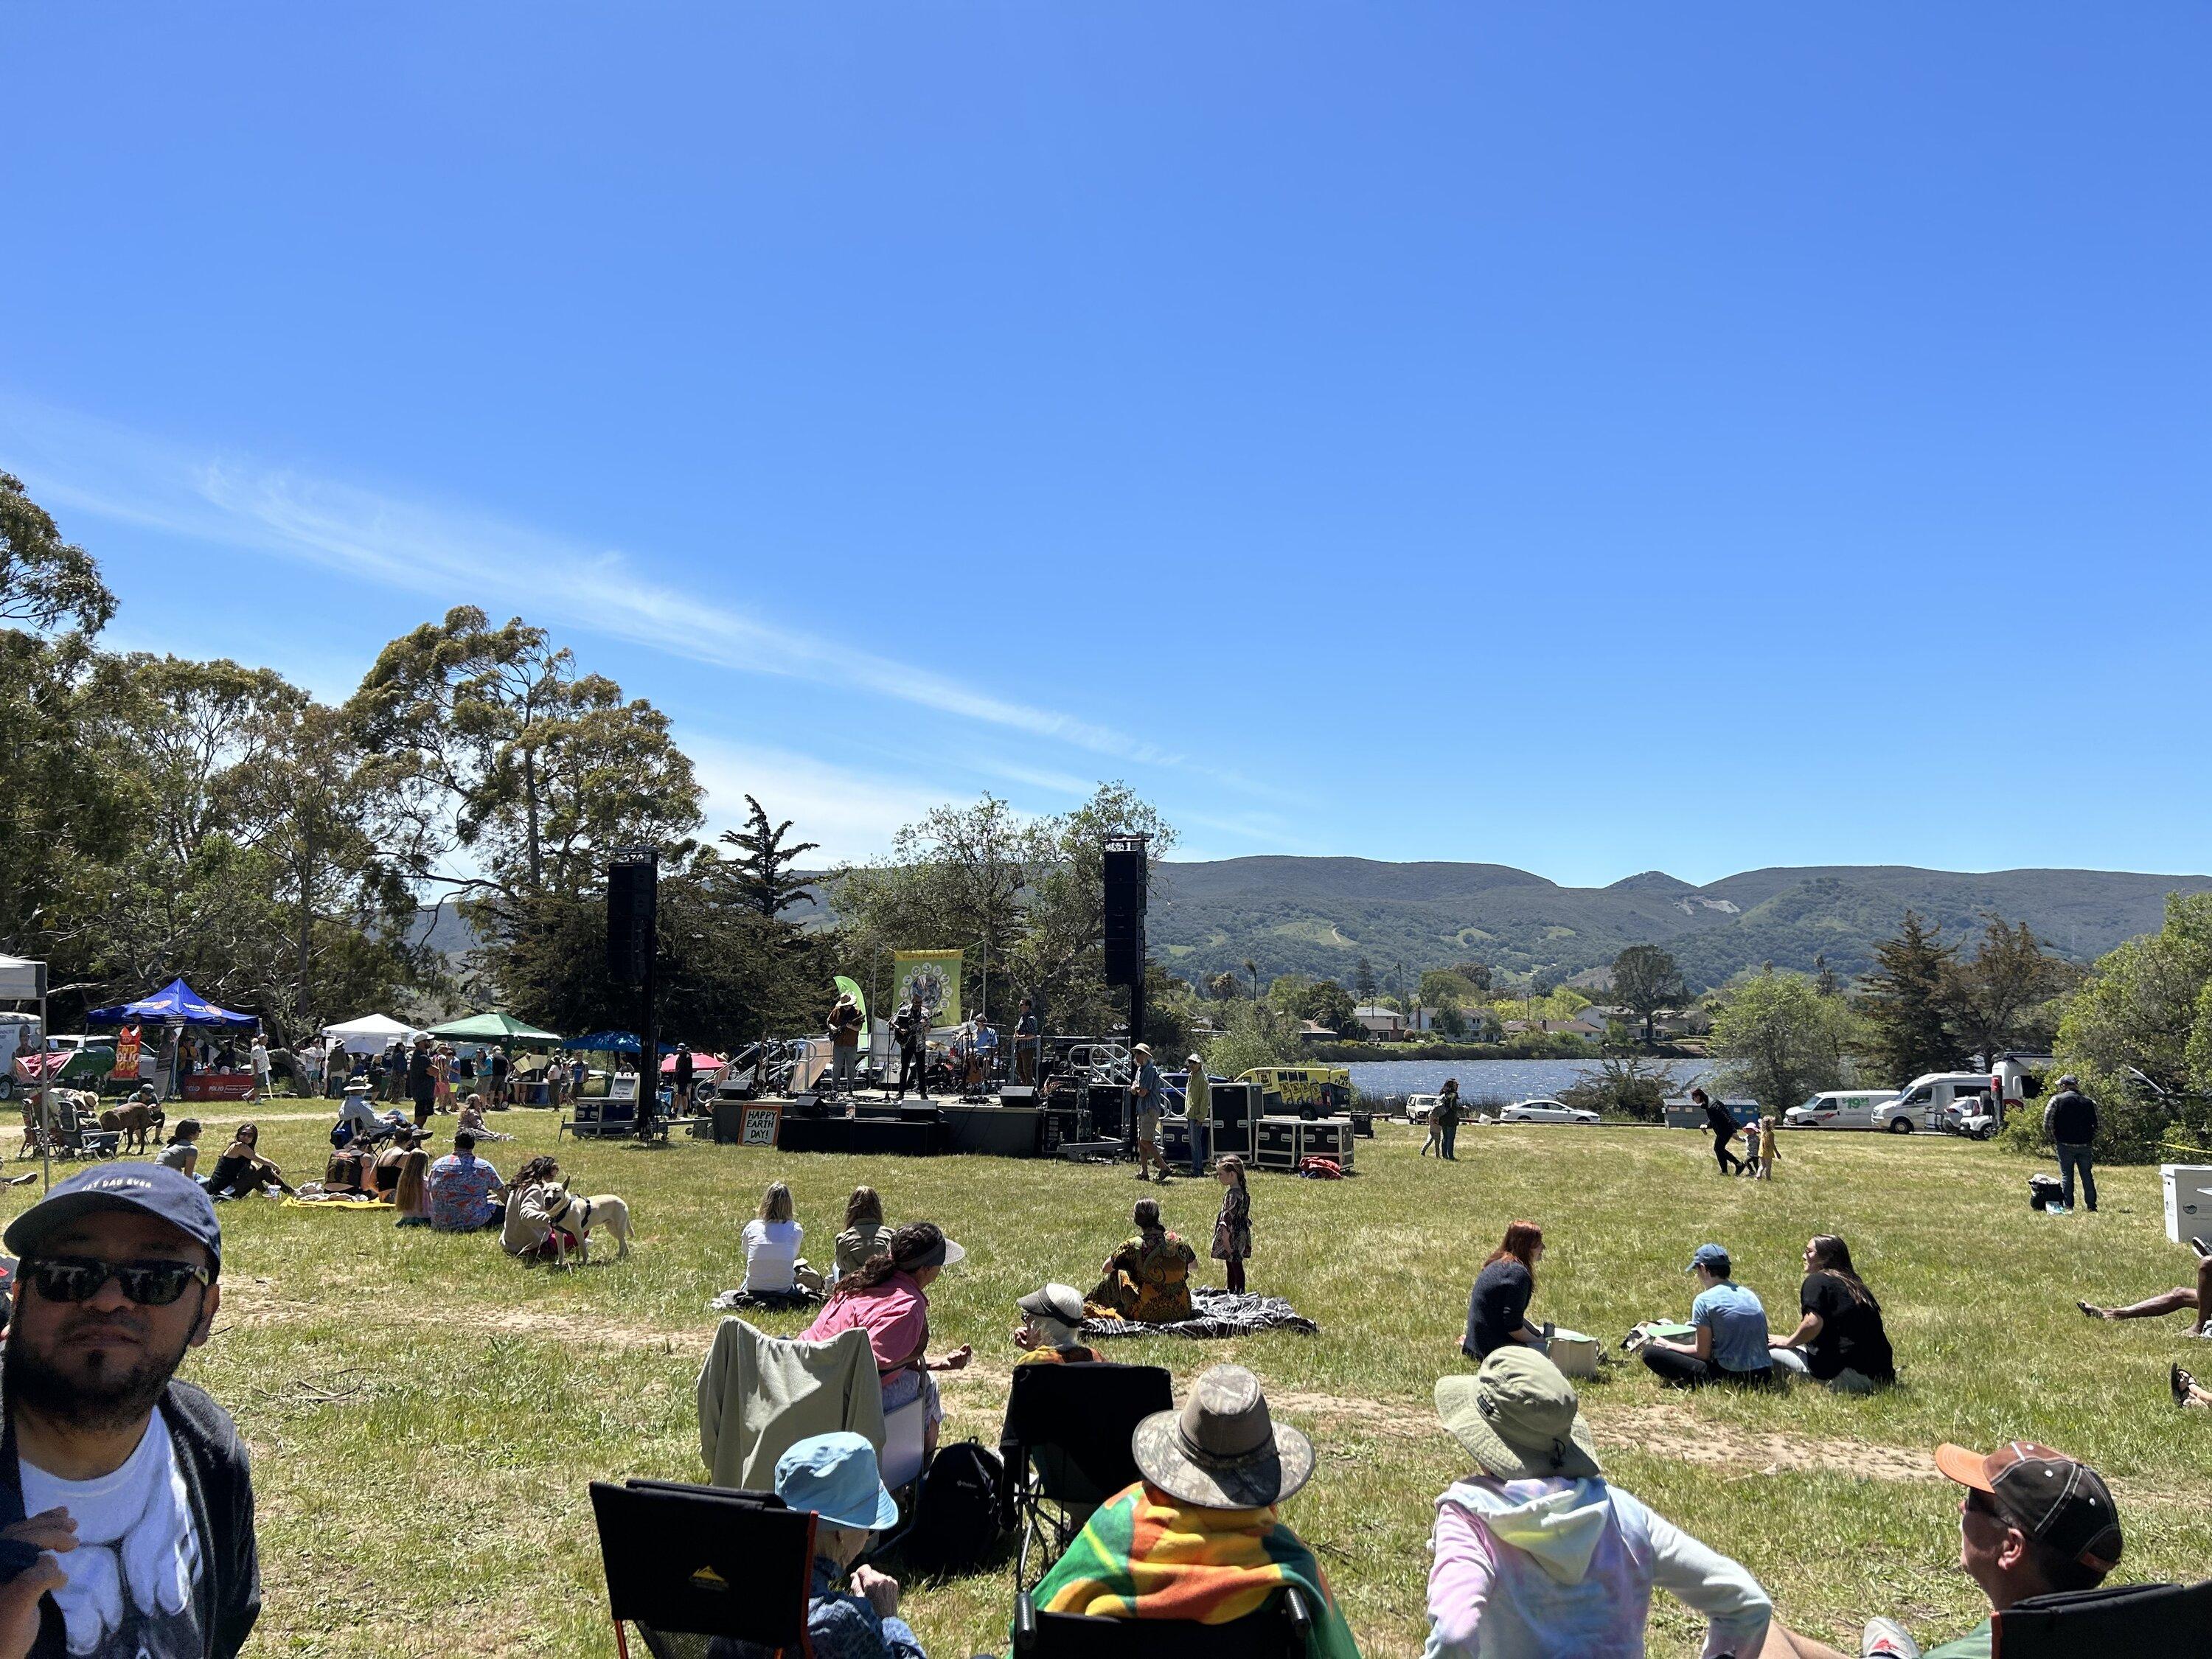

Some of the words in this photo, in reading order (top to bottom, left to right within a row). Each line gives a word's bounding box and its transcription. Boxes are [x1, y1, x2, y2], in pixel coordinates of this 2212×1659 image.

[748, 1110, 777, 1120] HAPPY
[746, 1120, 775, 1128] EARTH
[750, 1130, 769, 1139] DAY!
[102, 1178, 123, 1188] DAD
[127, 1178, 152, 1189] EVER
